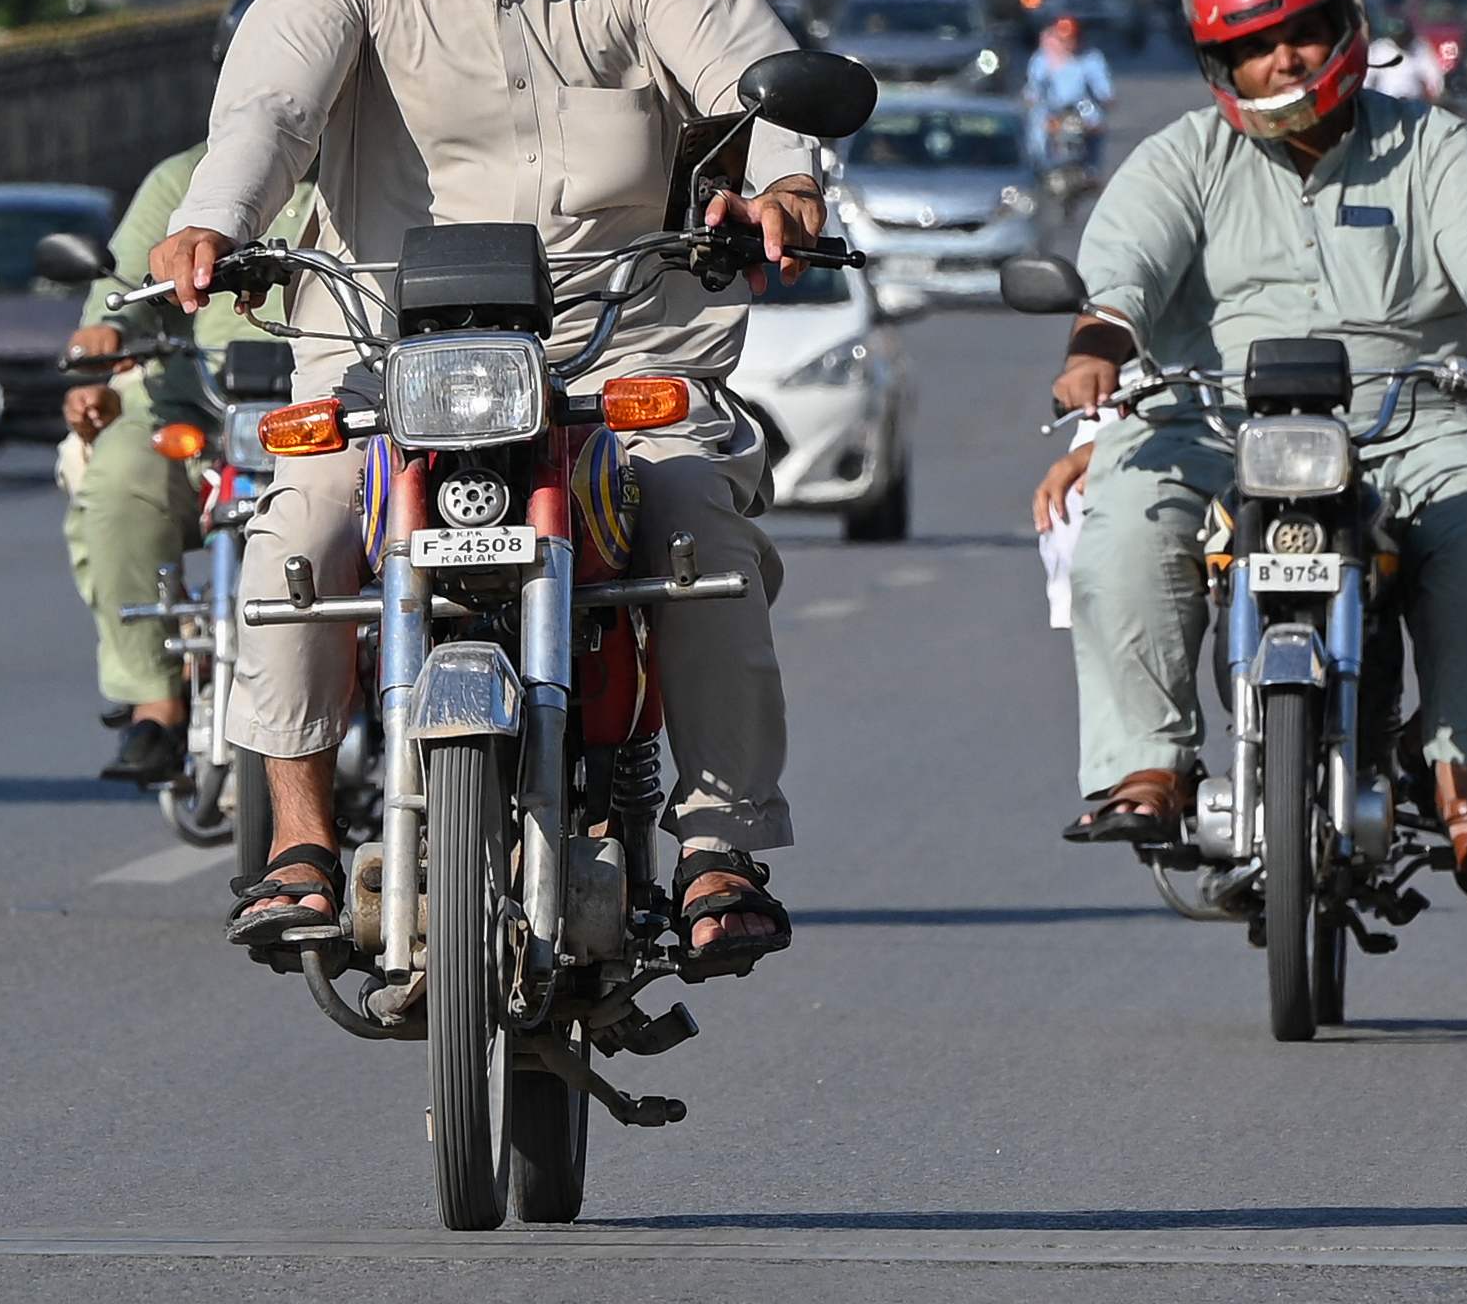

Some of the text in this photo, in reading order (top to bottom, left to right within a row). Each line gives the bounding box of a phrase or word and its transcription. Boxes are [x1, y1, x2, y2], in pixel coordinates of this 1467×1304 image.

[423, 537, 523, 555] F-4508
[441, 553, 497, 564] KARAK
[1283, 565, 1329, 582] 9754
